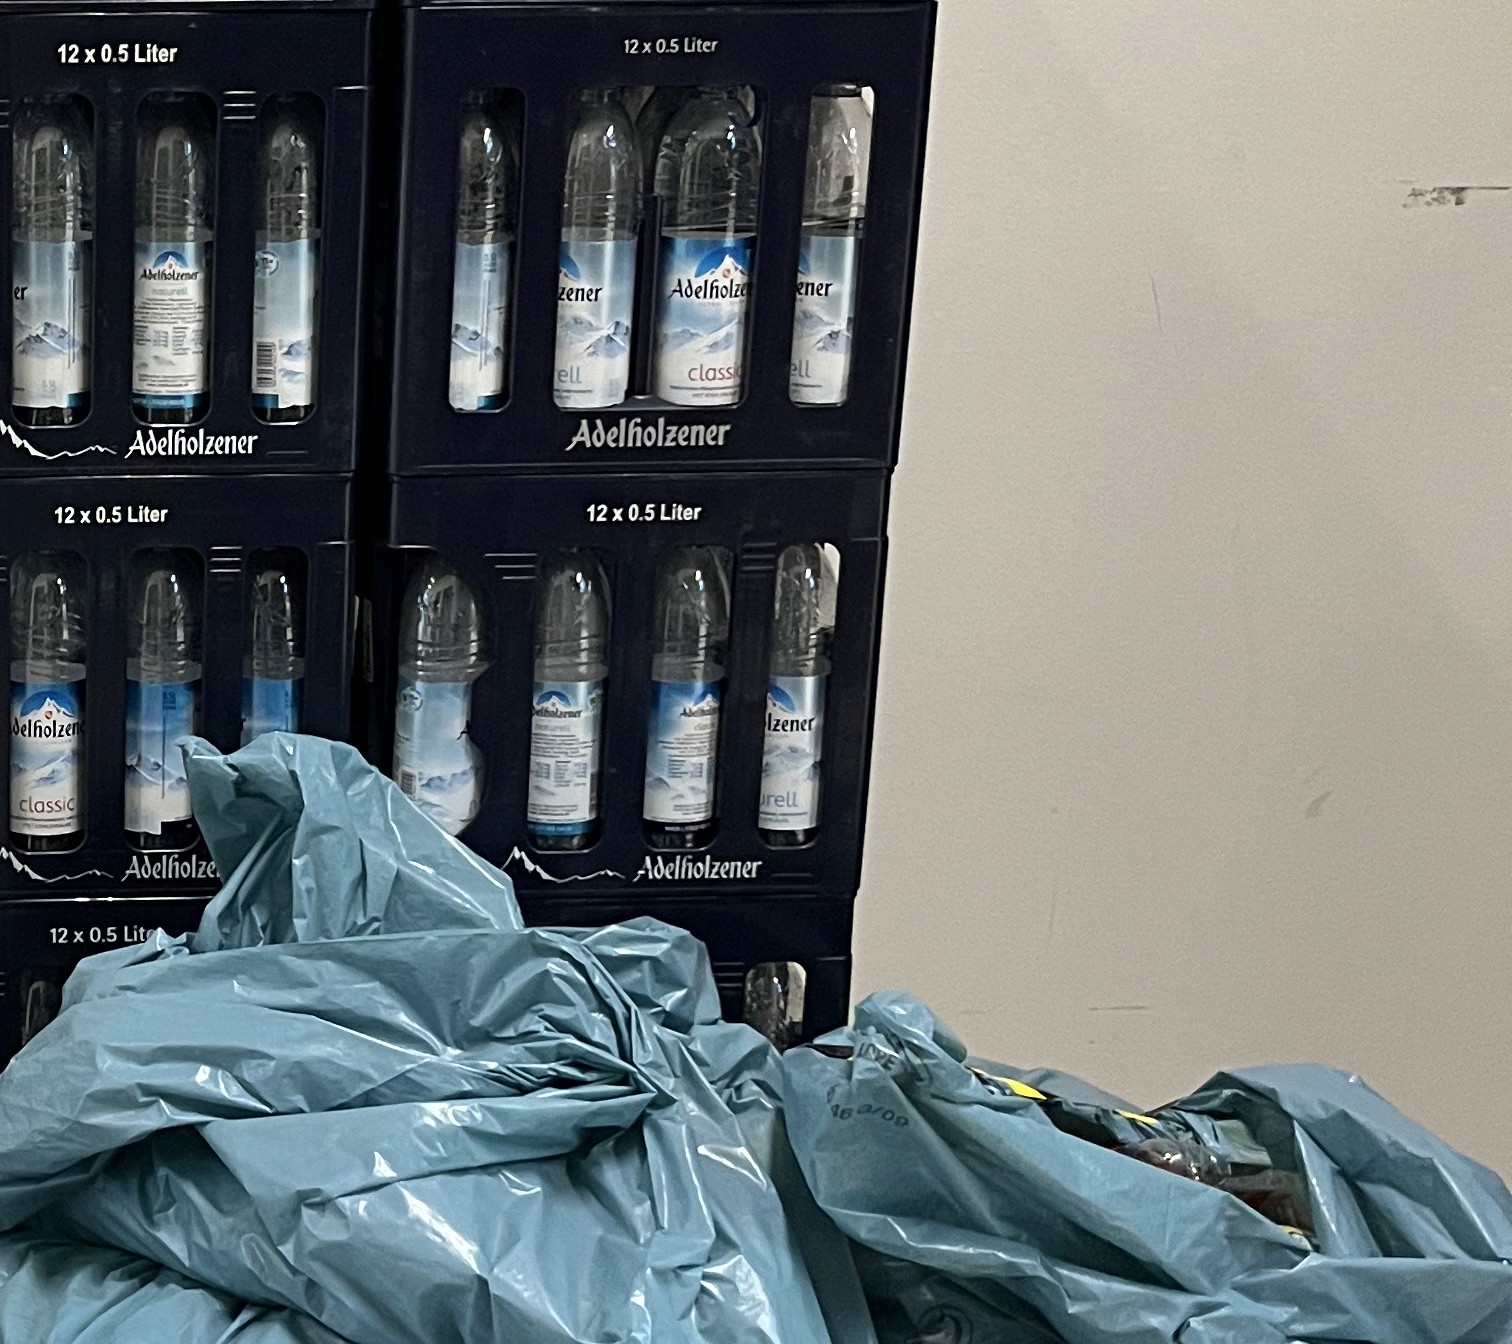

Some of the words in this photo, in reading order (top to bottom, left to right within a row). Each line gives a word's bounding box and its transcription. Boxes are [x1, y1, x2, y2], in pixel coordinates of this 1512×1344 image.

[57, 44, 80, 64] 12
[85, 49, 96, 64] x
[101, 44, 129, 64] 0.5
[135, 44, 178, 65] Liter
[623, 39, 640, 54] 12
[642, 43, 652, 54] x
[656, 39, 679, 54] 0.5
[684, 37, 718, 53] Liter
[125, 429, 258, 459] Adelholzener
[566, 418, 731, 451] Adelholzener
[55, 507, 75, 524] 12
[79, 511, 90, 524] x
[95, 507, 122, 524] 0.5
[127, 507, 169, 524] Liter
[587, 505, 607, 522] 12
[612, 509, 624, 522] x
[628, 505, 656, 522] 0.5
[661, 503, 702, 522] Liter
[19, 796, 75, 813] classic
[121, 854, 221, 882] Adelholze
[634, 855, 763, 883] Adelholzener
[49, 927, 69, 944] 12
[73, 932, 84, 943] x
[90, 926, 118, 943] 0.5
[124, 926, 156, 943] Lite
